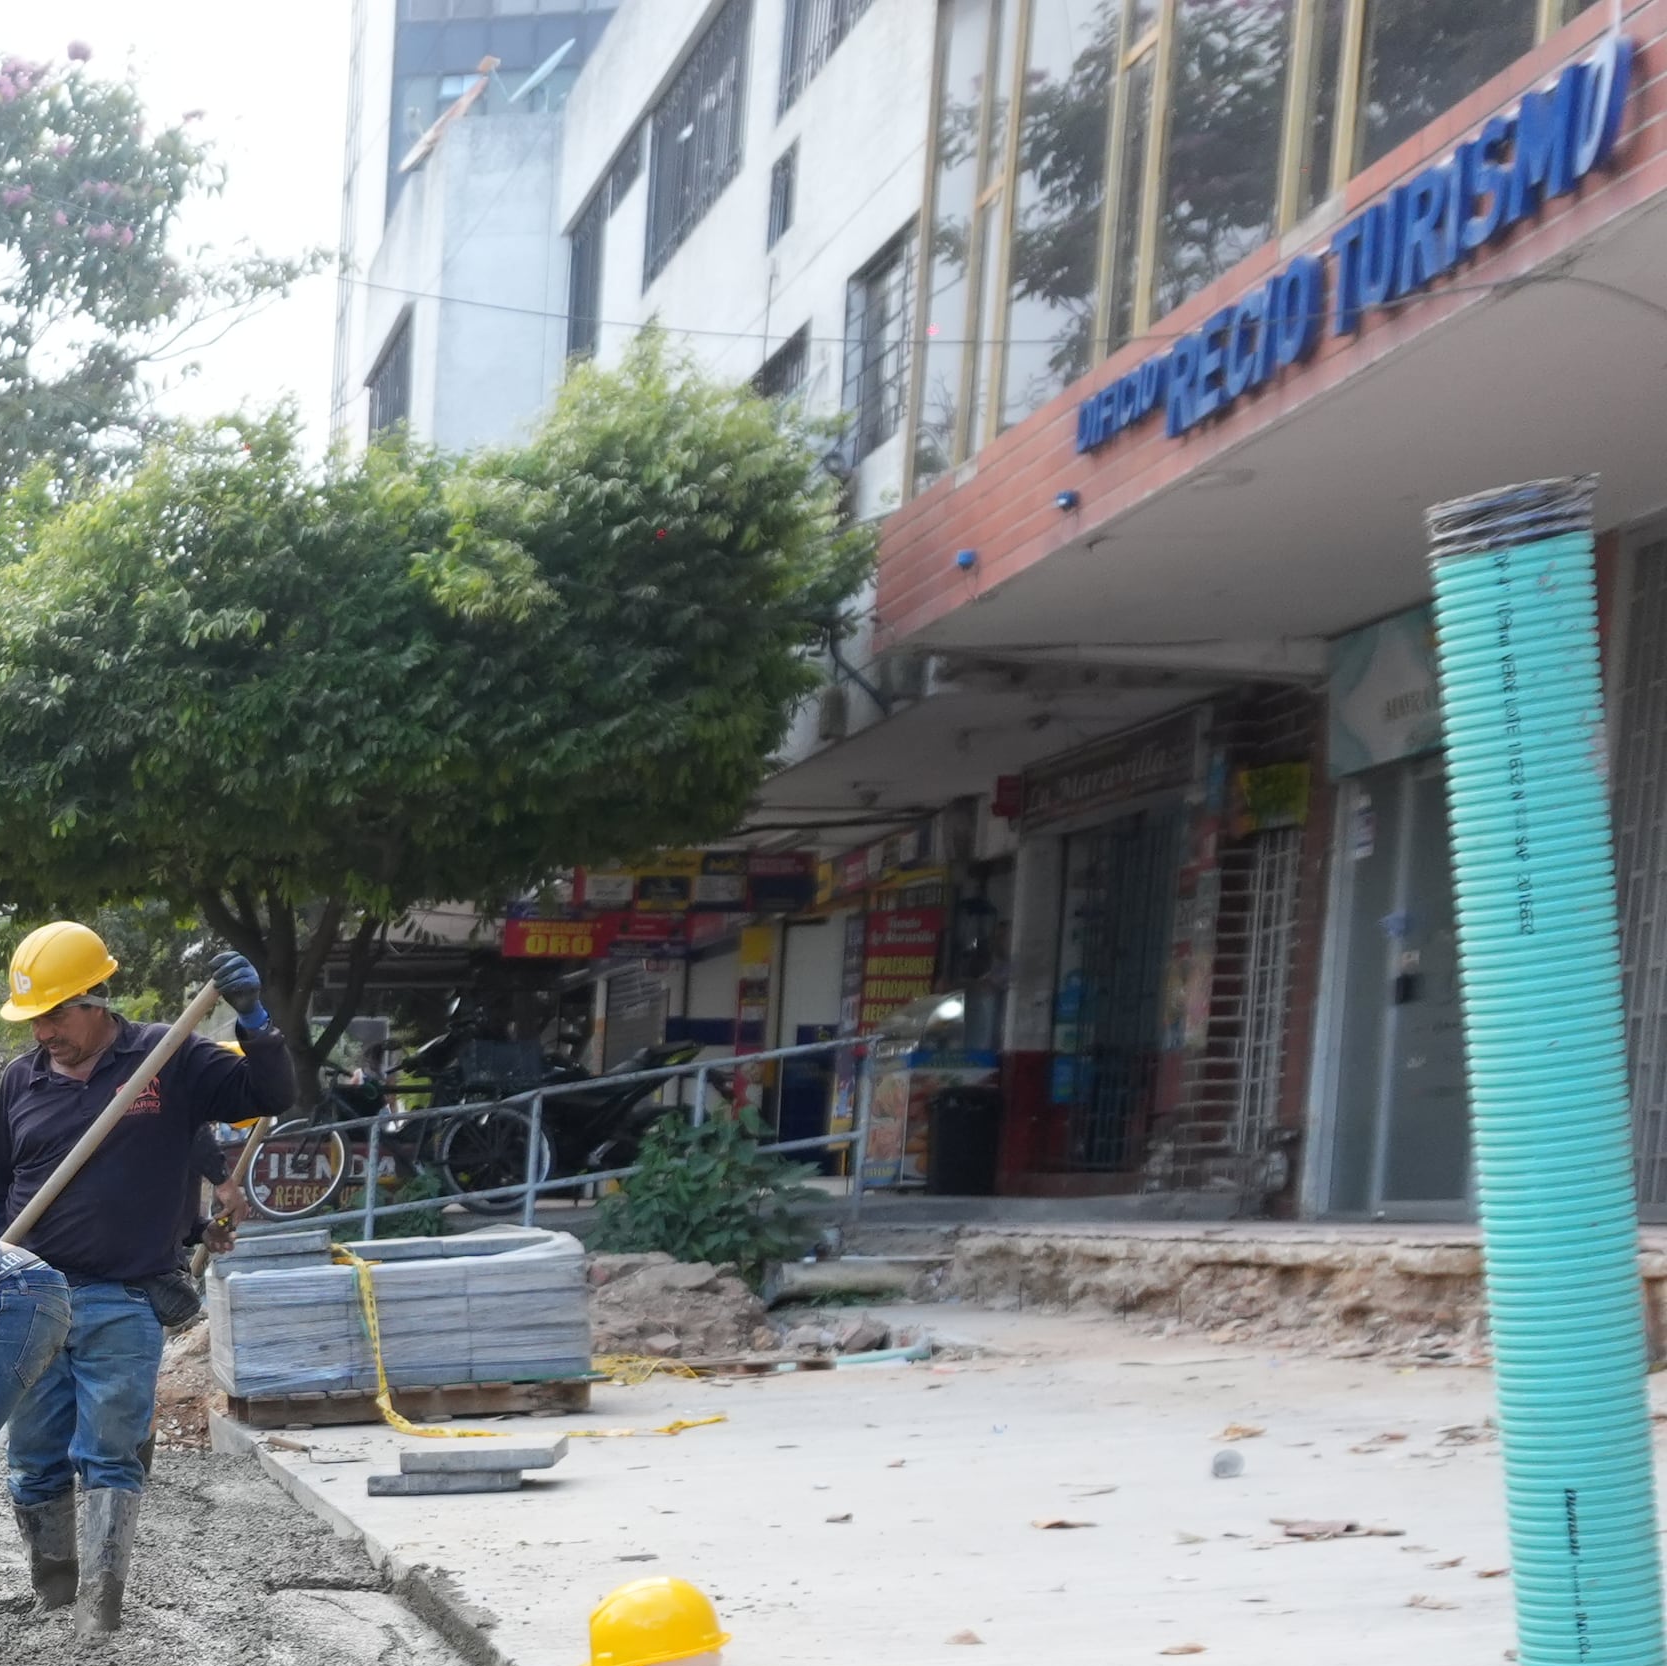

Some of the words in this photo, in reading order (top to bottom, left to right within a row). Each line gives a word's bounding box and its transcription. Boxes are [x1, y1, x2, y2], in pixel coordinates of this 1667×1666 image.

[1166, 255, 1324, 437] RECIO
[1329, 36, 1634, 338] TURISMO
[1502, 652, 1519, 695] VERDE
[1505, 697, 1523, 736] LOTE
[526, 934, 594, 955] ORO
